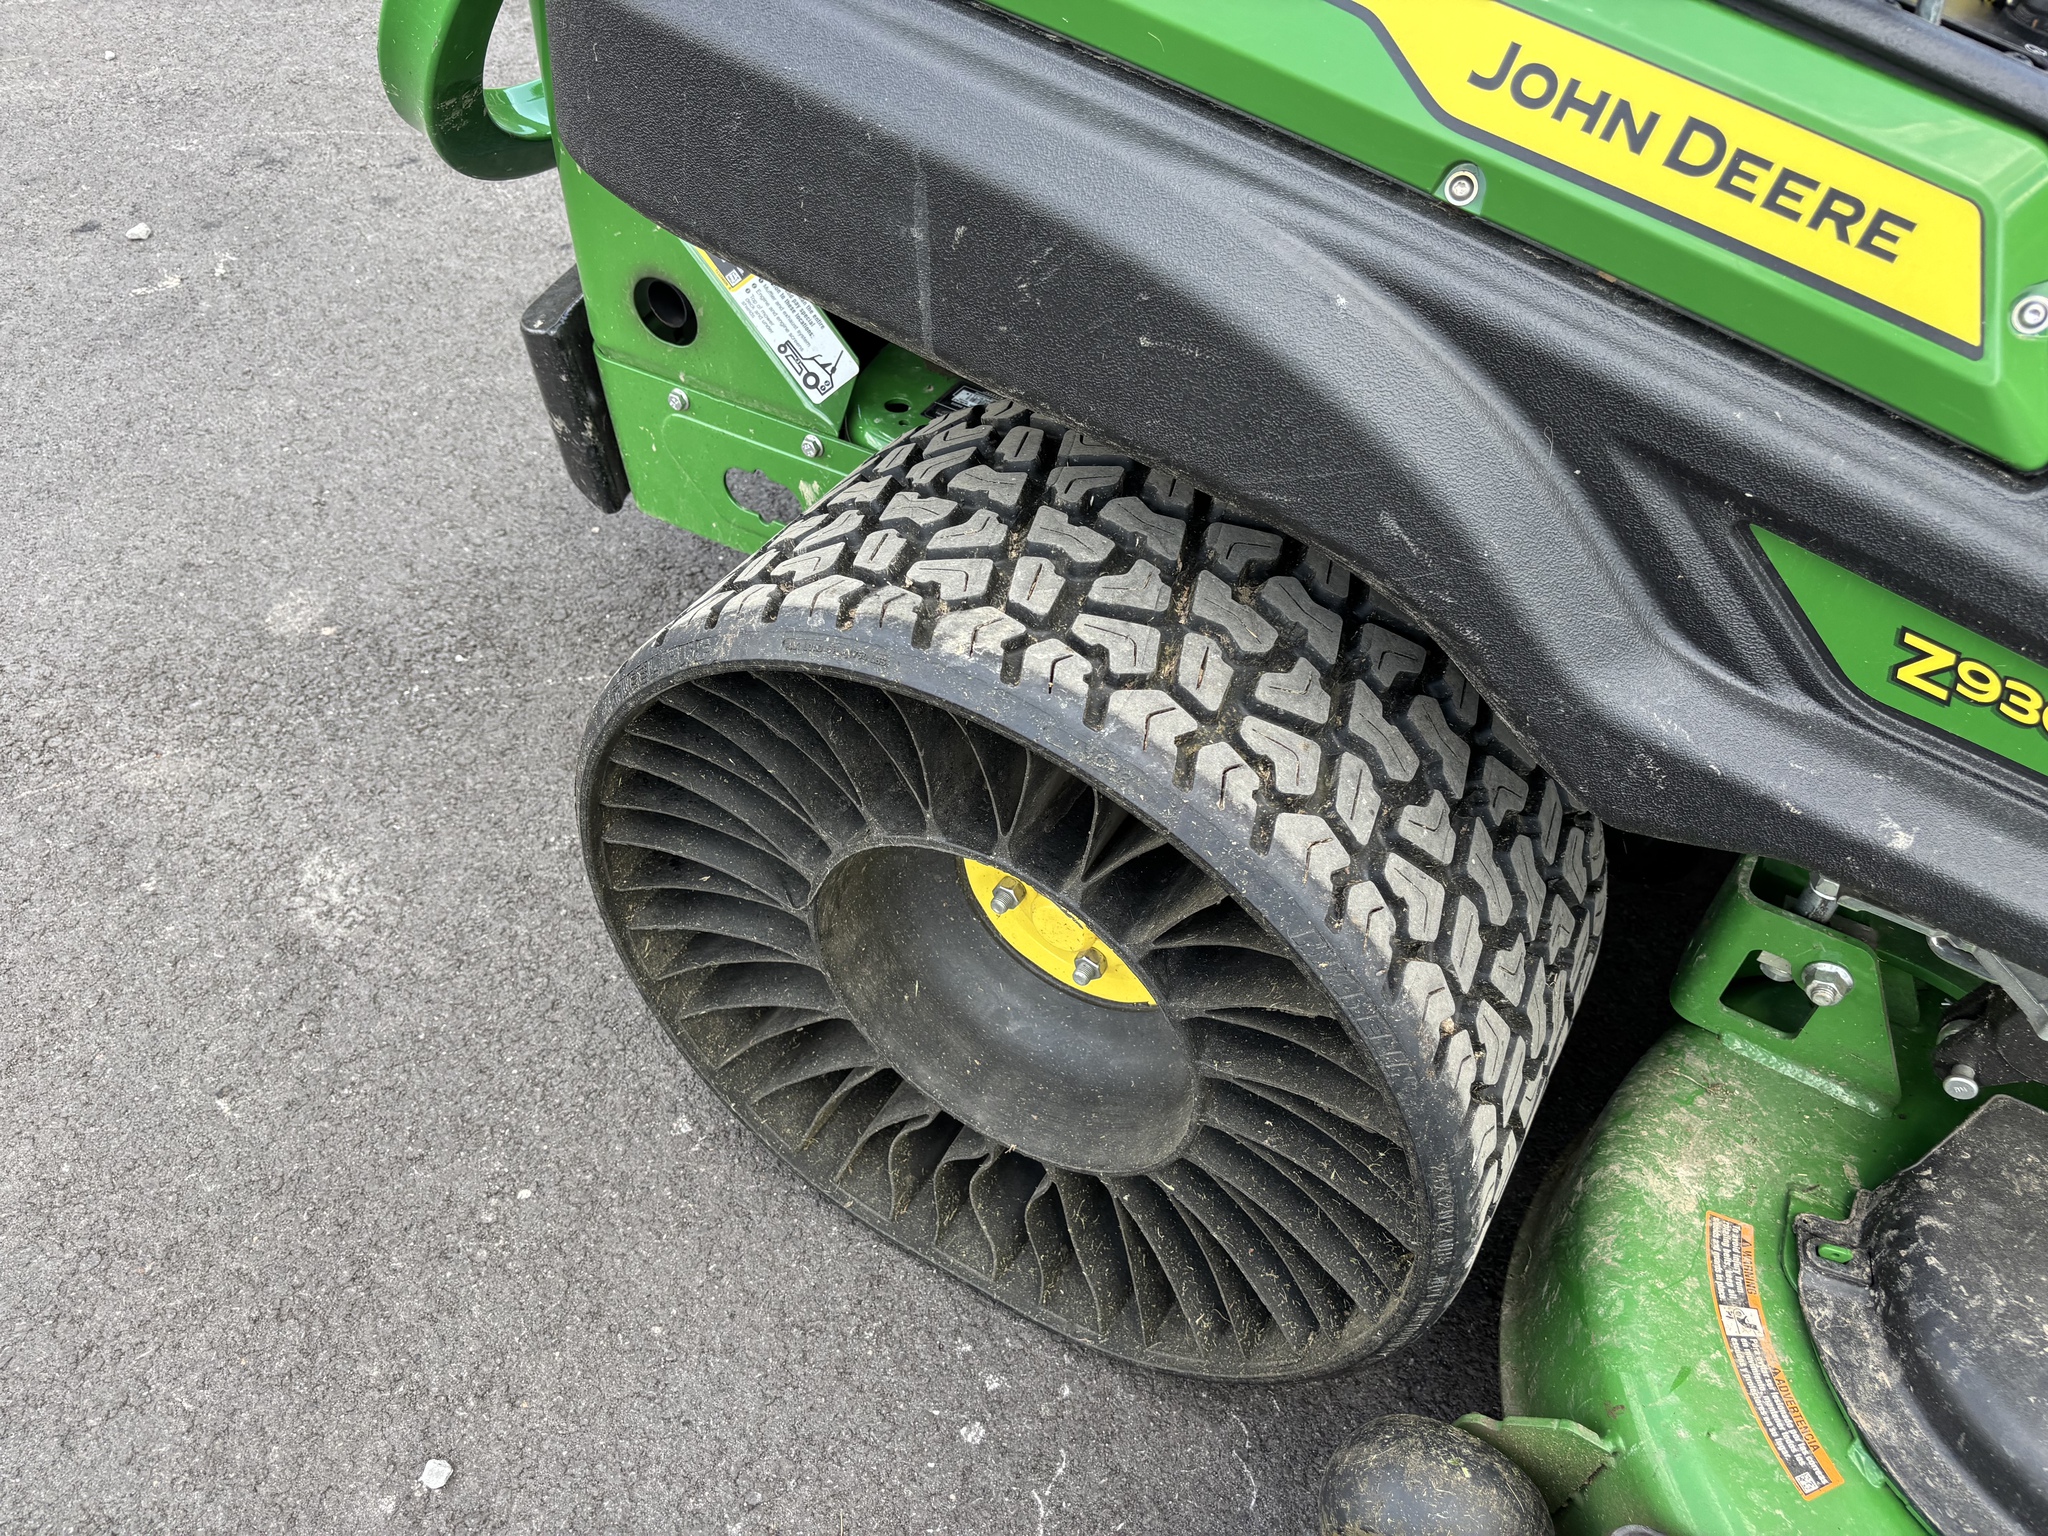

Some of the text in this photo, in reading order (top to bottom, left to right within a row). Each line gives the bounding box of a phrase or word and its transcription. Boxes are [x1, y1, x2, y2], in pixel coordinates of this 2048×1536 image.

[1467, 42, 1917, 264] JOHN DEERE
[740, 299, 756, 319] shields
[744, 296, 774, 334] deck and under
[748, 293, 759, 305] Top
[755, 302, 763, 310] of
[759, 308, 775, 327] mower
[754, 288, 771, 308] Engine
[768, 305, 778, 317] and
[774, 314, 791, 334] engine
[787, 331, 805, 352] screens
[778, 292, 786, 300] to
[783, 298, 797, 314] these
[790, 297, 801, 310] pay
[797, 307, 815, 328] special
[804, 304, 826, 330] the entire
[773, 299, 785, 312] and
[781, 309, 799, 330] exhaust
[794, 328, 812, 348] system
[1891, 626, 2048, 742] Z93
[1721, 1220, 1731, 1247] rotating
[1731, 1224, 1744, 1293] To avoid injury from
[1742, 1249, 1757, 1295] WARNING
[1724, 1269, 1733, 1287] keep
[1728, 1288, 1737, 1299] all
[1739, 1337, 1749, 1349] en
[1762, 1394, 1787, 1432] mantener
[1781, 1430, 1798, 1454] todos
[1793, 1452, 1806, 1467] los
[1748, 1336, 1762, 1356] Para
[1764, 1377, 1775, 1391] ser
[1770, 1390, 1794, 1429] lesionado
[1788, 1427, 1802, 1444] por
[1797, 1441, 1810, 1456] las
[1804, 1455, 1829, 1485] correas
[1774, 1375, 1820, 1452] ADVERTENCIA
[1762, 1415, 1773, 1427] en
[1767, 1426, 1779, 1438] su
